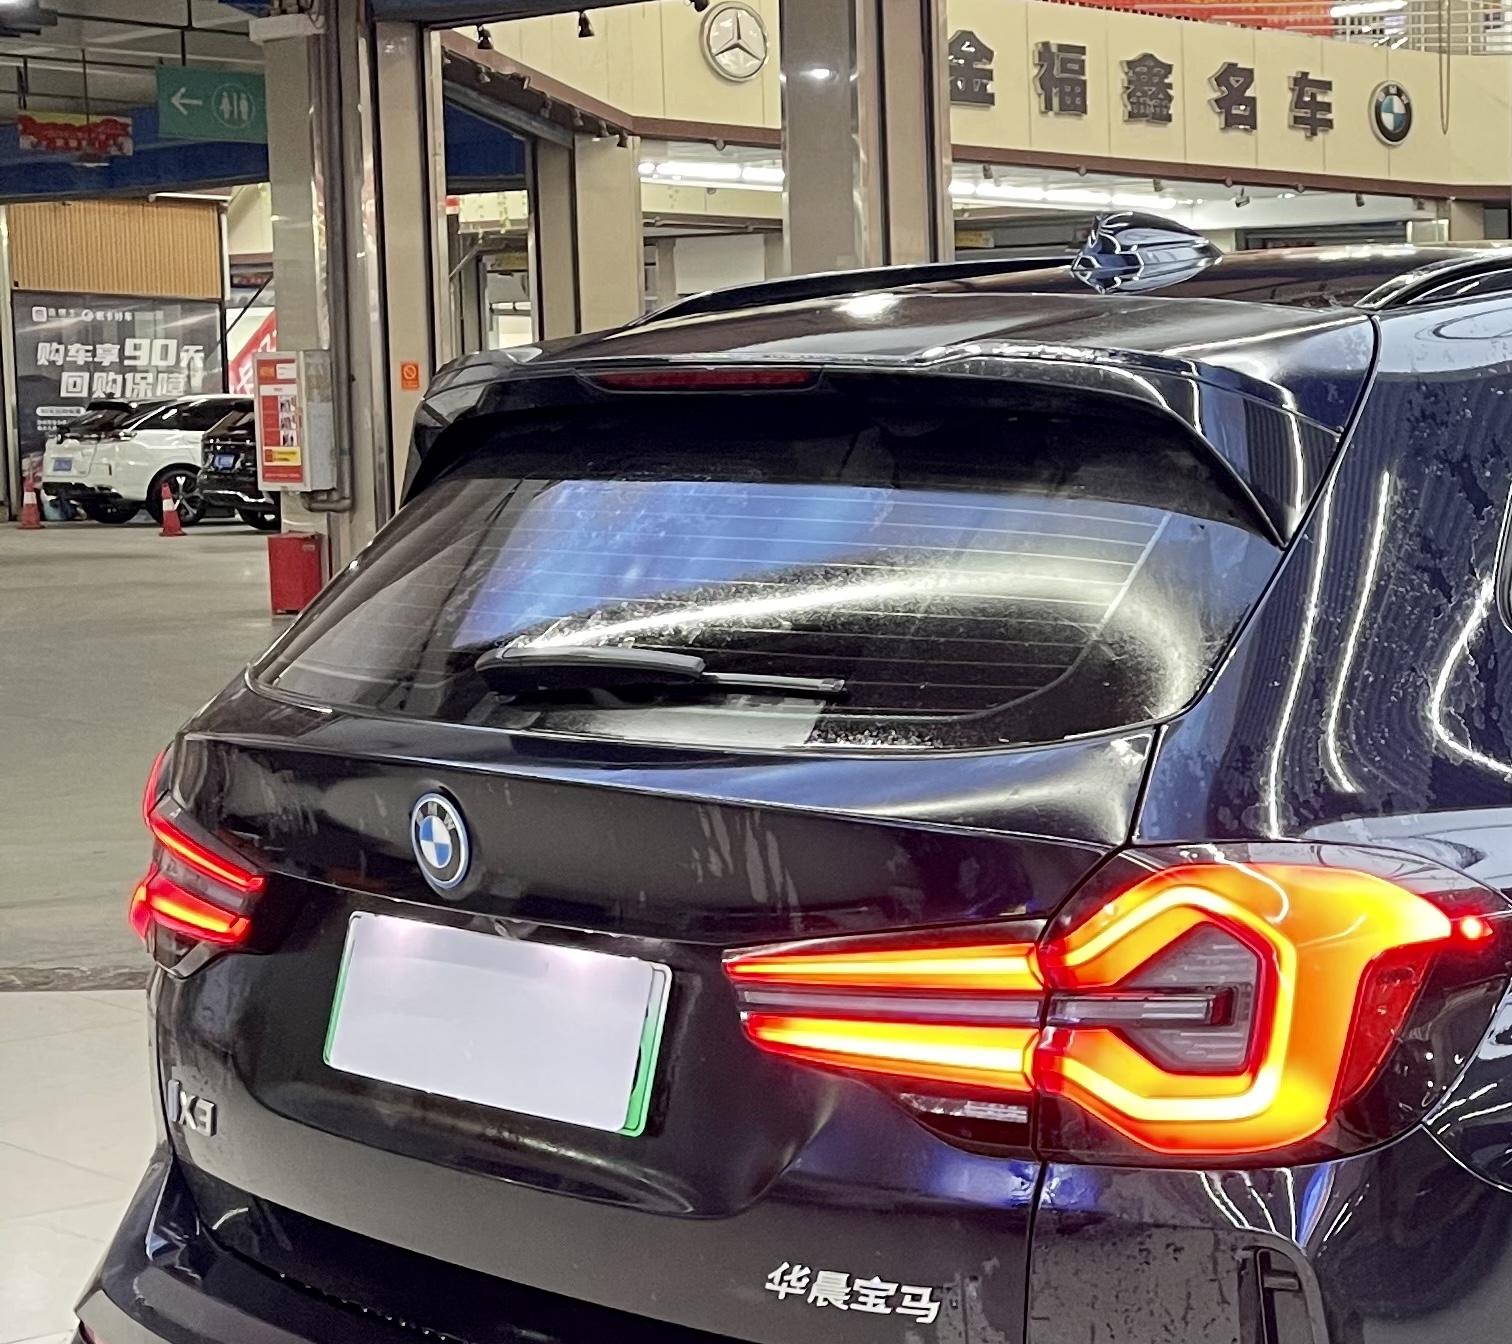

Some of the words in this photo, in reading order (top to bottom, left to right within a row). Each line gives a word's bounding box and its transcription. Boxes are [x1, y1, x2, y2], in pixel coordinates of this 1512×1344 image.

[948, 29, 1334, 141] 金福鑫名车
[765, 1261, 941, 1324] 华晨宝马
